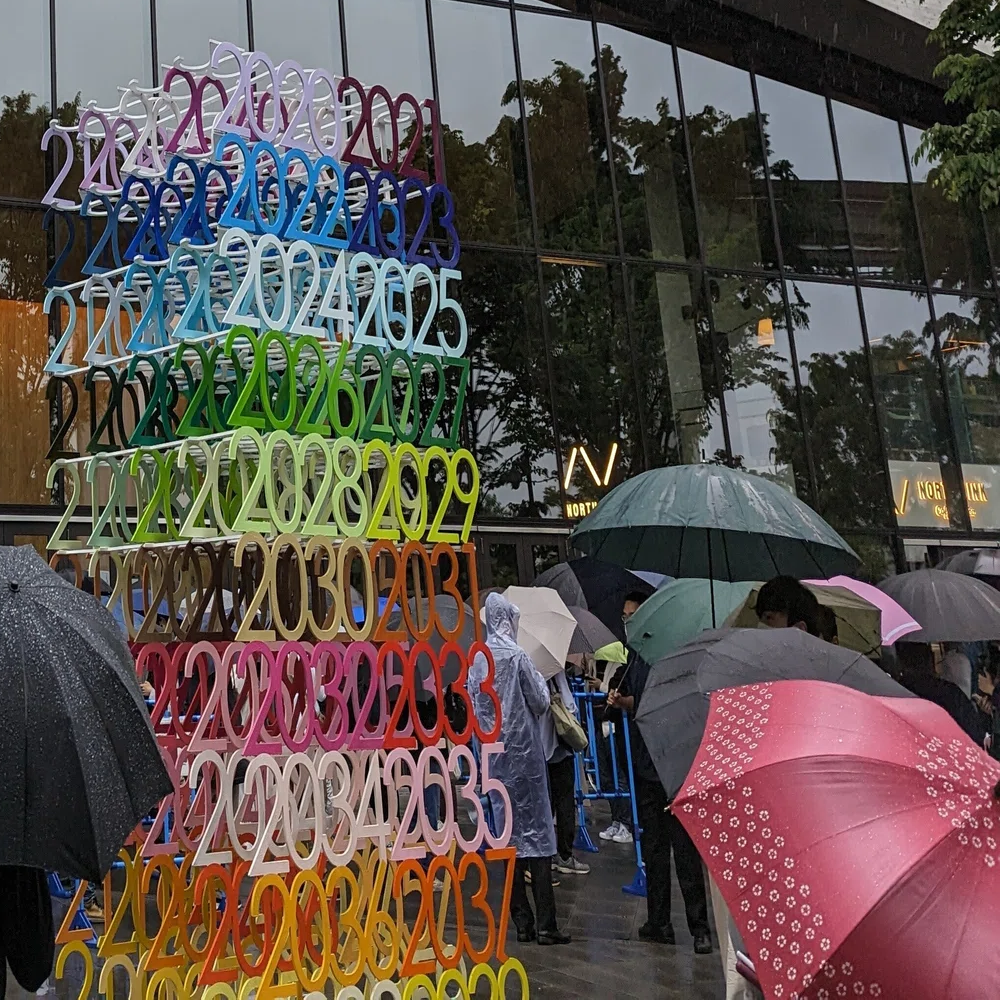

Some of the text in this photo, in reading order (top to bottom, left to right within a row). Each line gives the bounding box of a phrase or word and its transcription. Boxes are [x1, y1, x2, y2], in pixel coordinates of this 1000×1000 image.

[212, 42, 341, 157] 2020
[337, 77, 446, 186] 2021
[216, 133, 349, 250] 2022
[343, 164, 461, 268] 2023
[220, 227, 354, 341] 2024
[351, 252, 468, 358] 2025
[225, 324, 360, 437] 2026
[355, 344, 471, 451] 2027
[229, 426, 368, 538] 2028
[363, 439, 480, 543] 2029
[917, 480, 946, 500] NORT
[234, 531, 375, 643] 2030
[369, 539, 482, 643] 2031
[238, 640, 386, 757] 2032
[377, 640, 501, 750] 2033
[244, 749, 391, 876] 2034
[384, 742, 513, 860] 2035
[252, 861, 400, 1000] 2036
[393, 847, 517, 977] 2037
